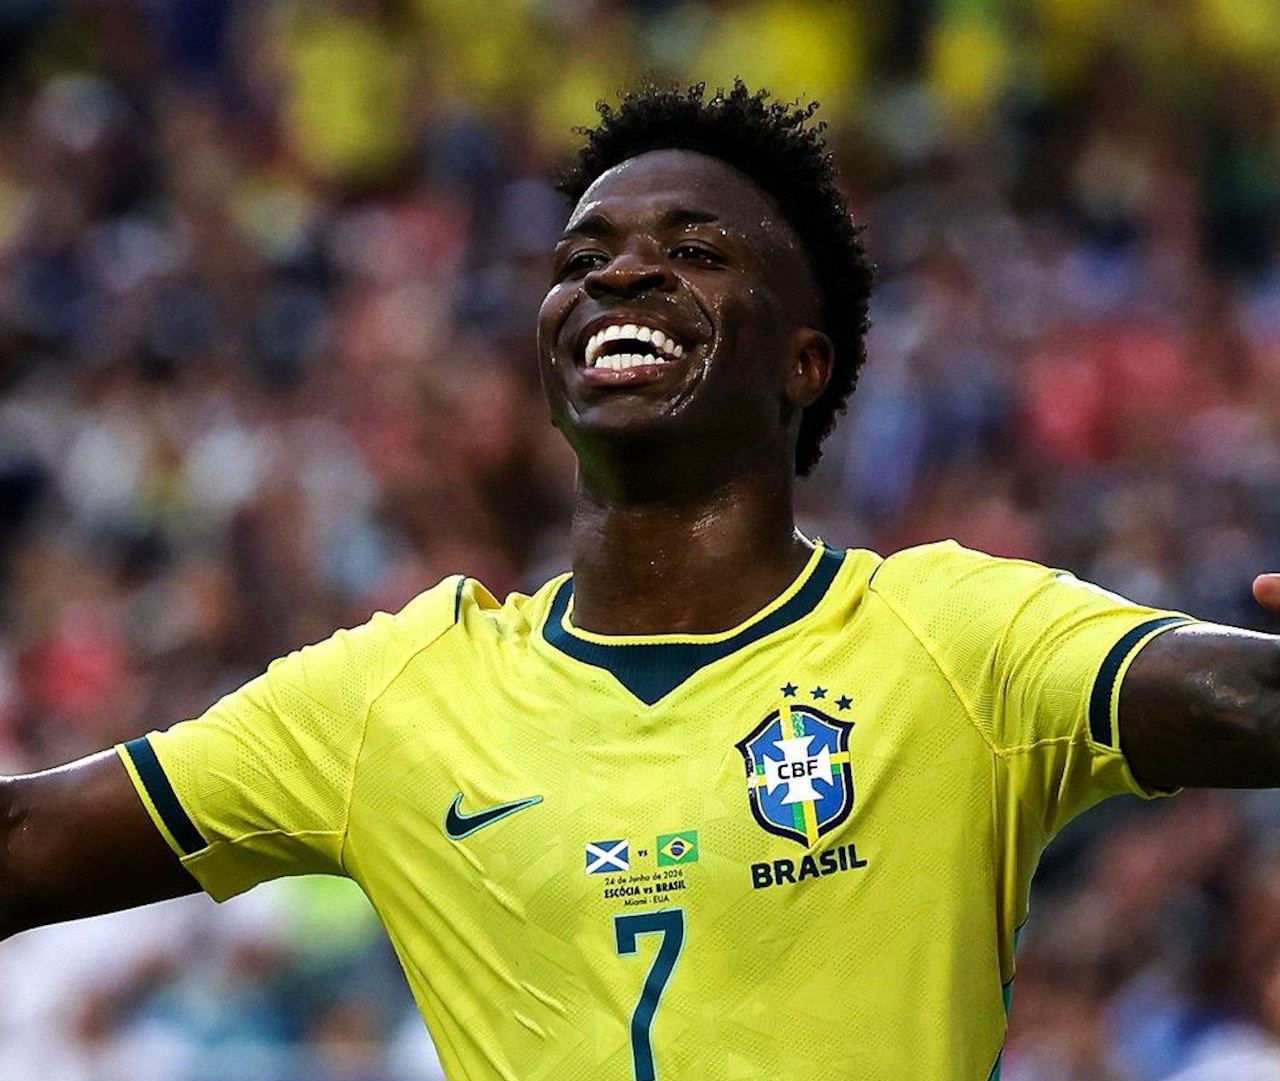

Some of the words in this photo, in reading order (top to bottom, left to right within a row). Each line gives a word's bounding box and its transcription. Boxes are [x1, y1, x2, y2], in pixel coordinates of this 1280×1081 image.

[778, 760, 818, 779] CBF
[751, 844, 868, 889] BRASIL
[617, 876, 626, 885] de
[629, 874, 650, 883] Junho
[652, 872, 661, 880] de
[663, 869, 683, 879] 2026
[604, 885, 640, 898] ESCÓCIA
[656, 880, 687, 892] BRASIL
[624, 896, 647, 906] Miami
[653, 895, 670, 904] EUA
